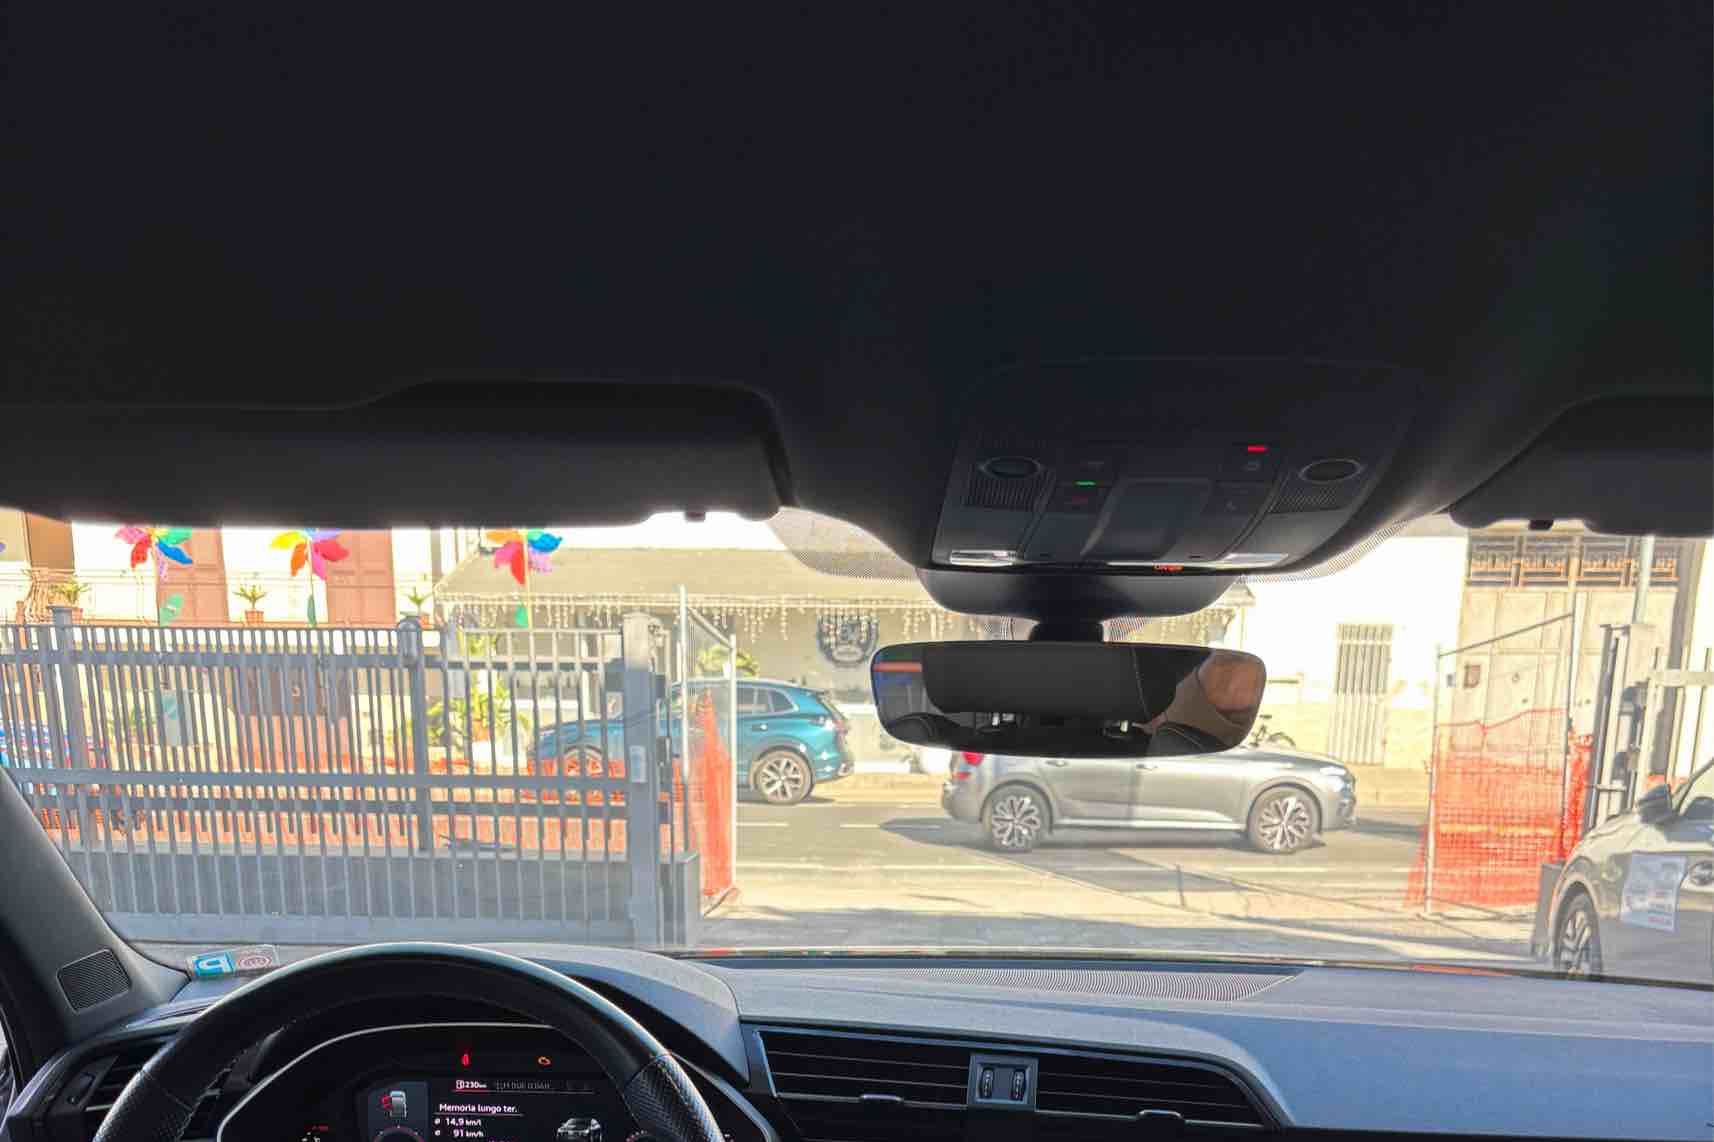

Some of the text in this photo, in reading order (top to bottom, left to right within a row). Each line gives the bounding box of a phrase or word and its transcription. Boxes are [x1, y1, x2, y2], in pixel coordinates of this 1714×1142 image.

[439, 1103, 518, 1115] Memoria lungo ter.
[453, 1129, 465, 1138] 91
